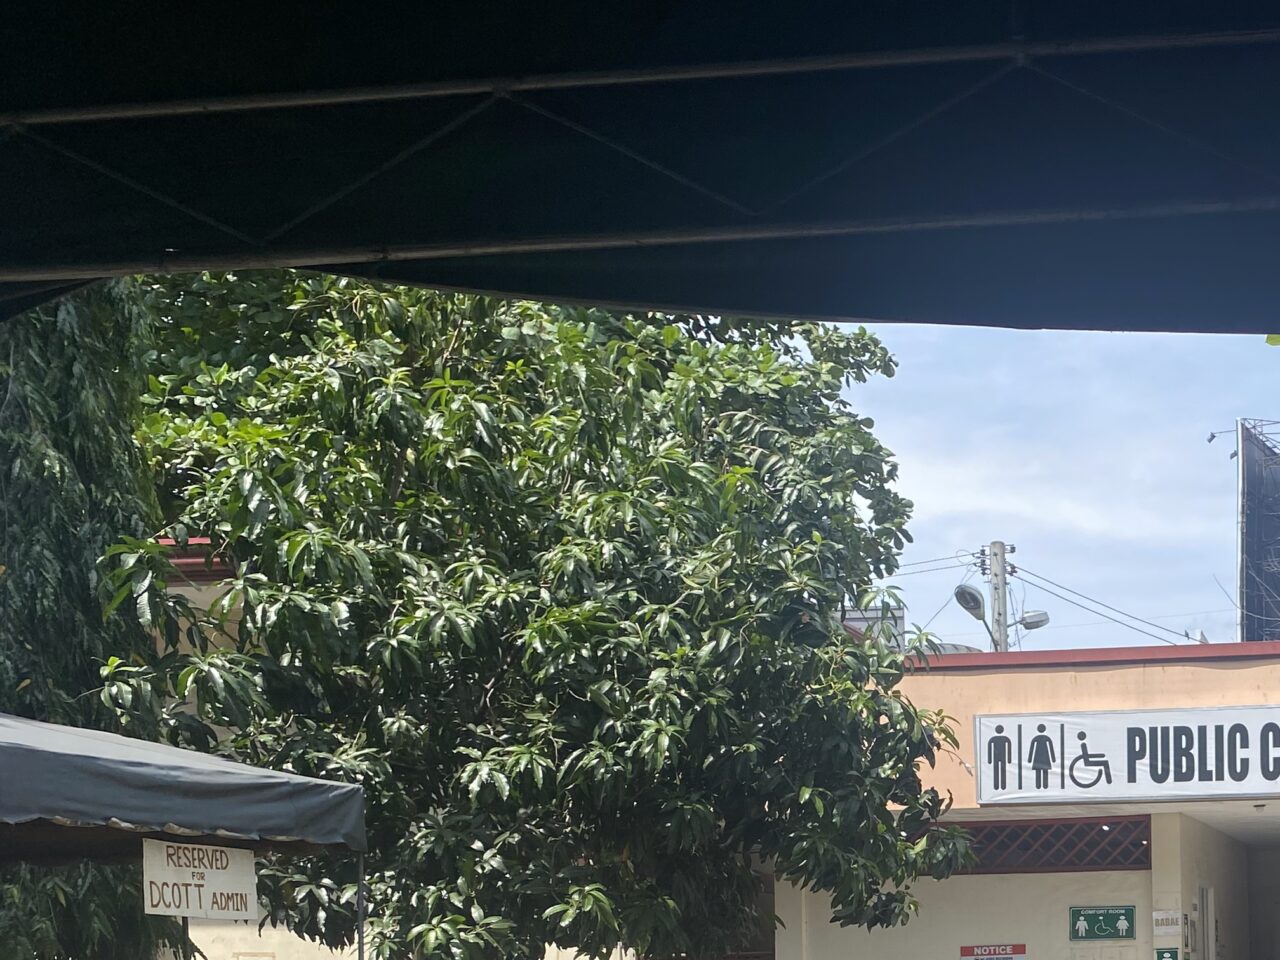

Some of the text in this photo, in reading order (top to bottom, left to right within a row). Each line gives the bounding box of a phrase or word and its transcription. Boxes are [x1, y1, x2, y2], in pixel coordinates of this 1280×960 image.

[1126, 723, 1249, 784] PUBLIC
[166, 845, 229, 870] RESERVED
[191, 871, 205, 881] FOR
[149, 880, 248, 912] DCOTT ADMIN
[1154, 918, 1179, 927] BABAE
[973, 945, 1013, 955] NOTICE
